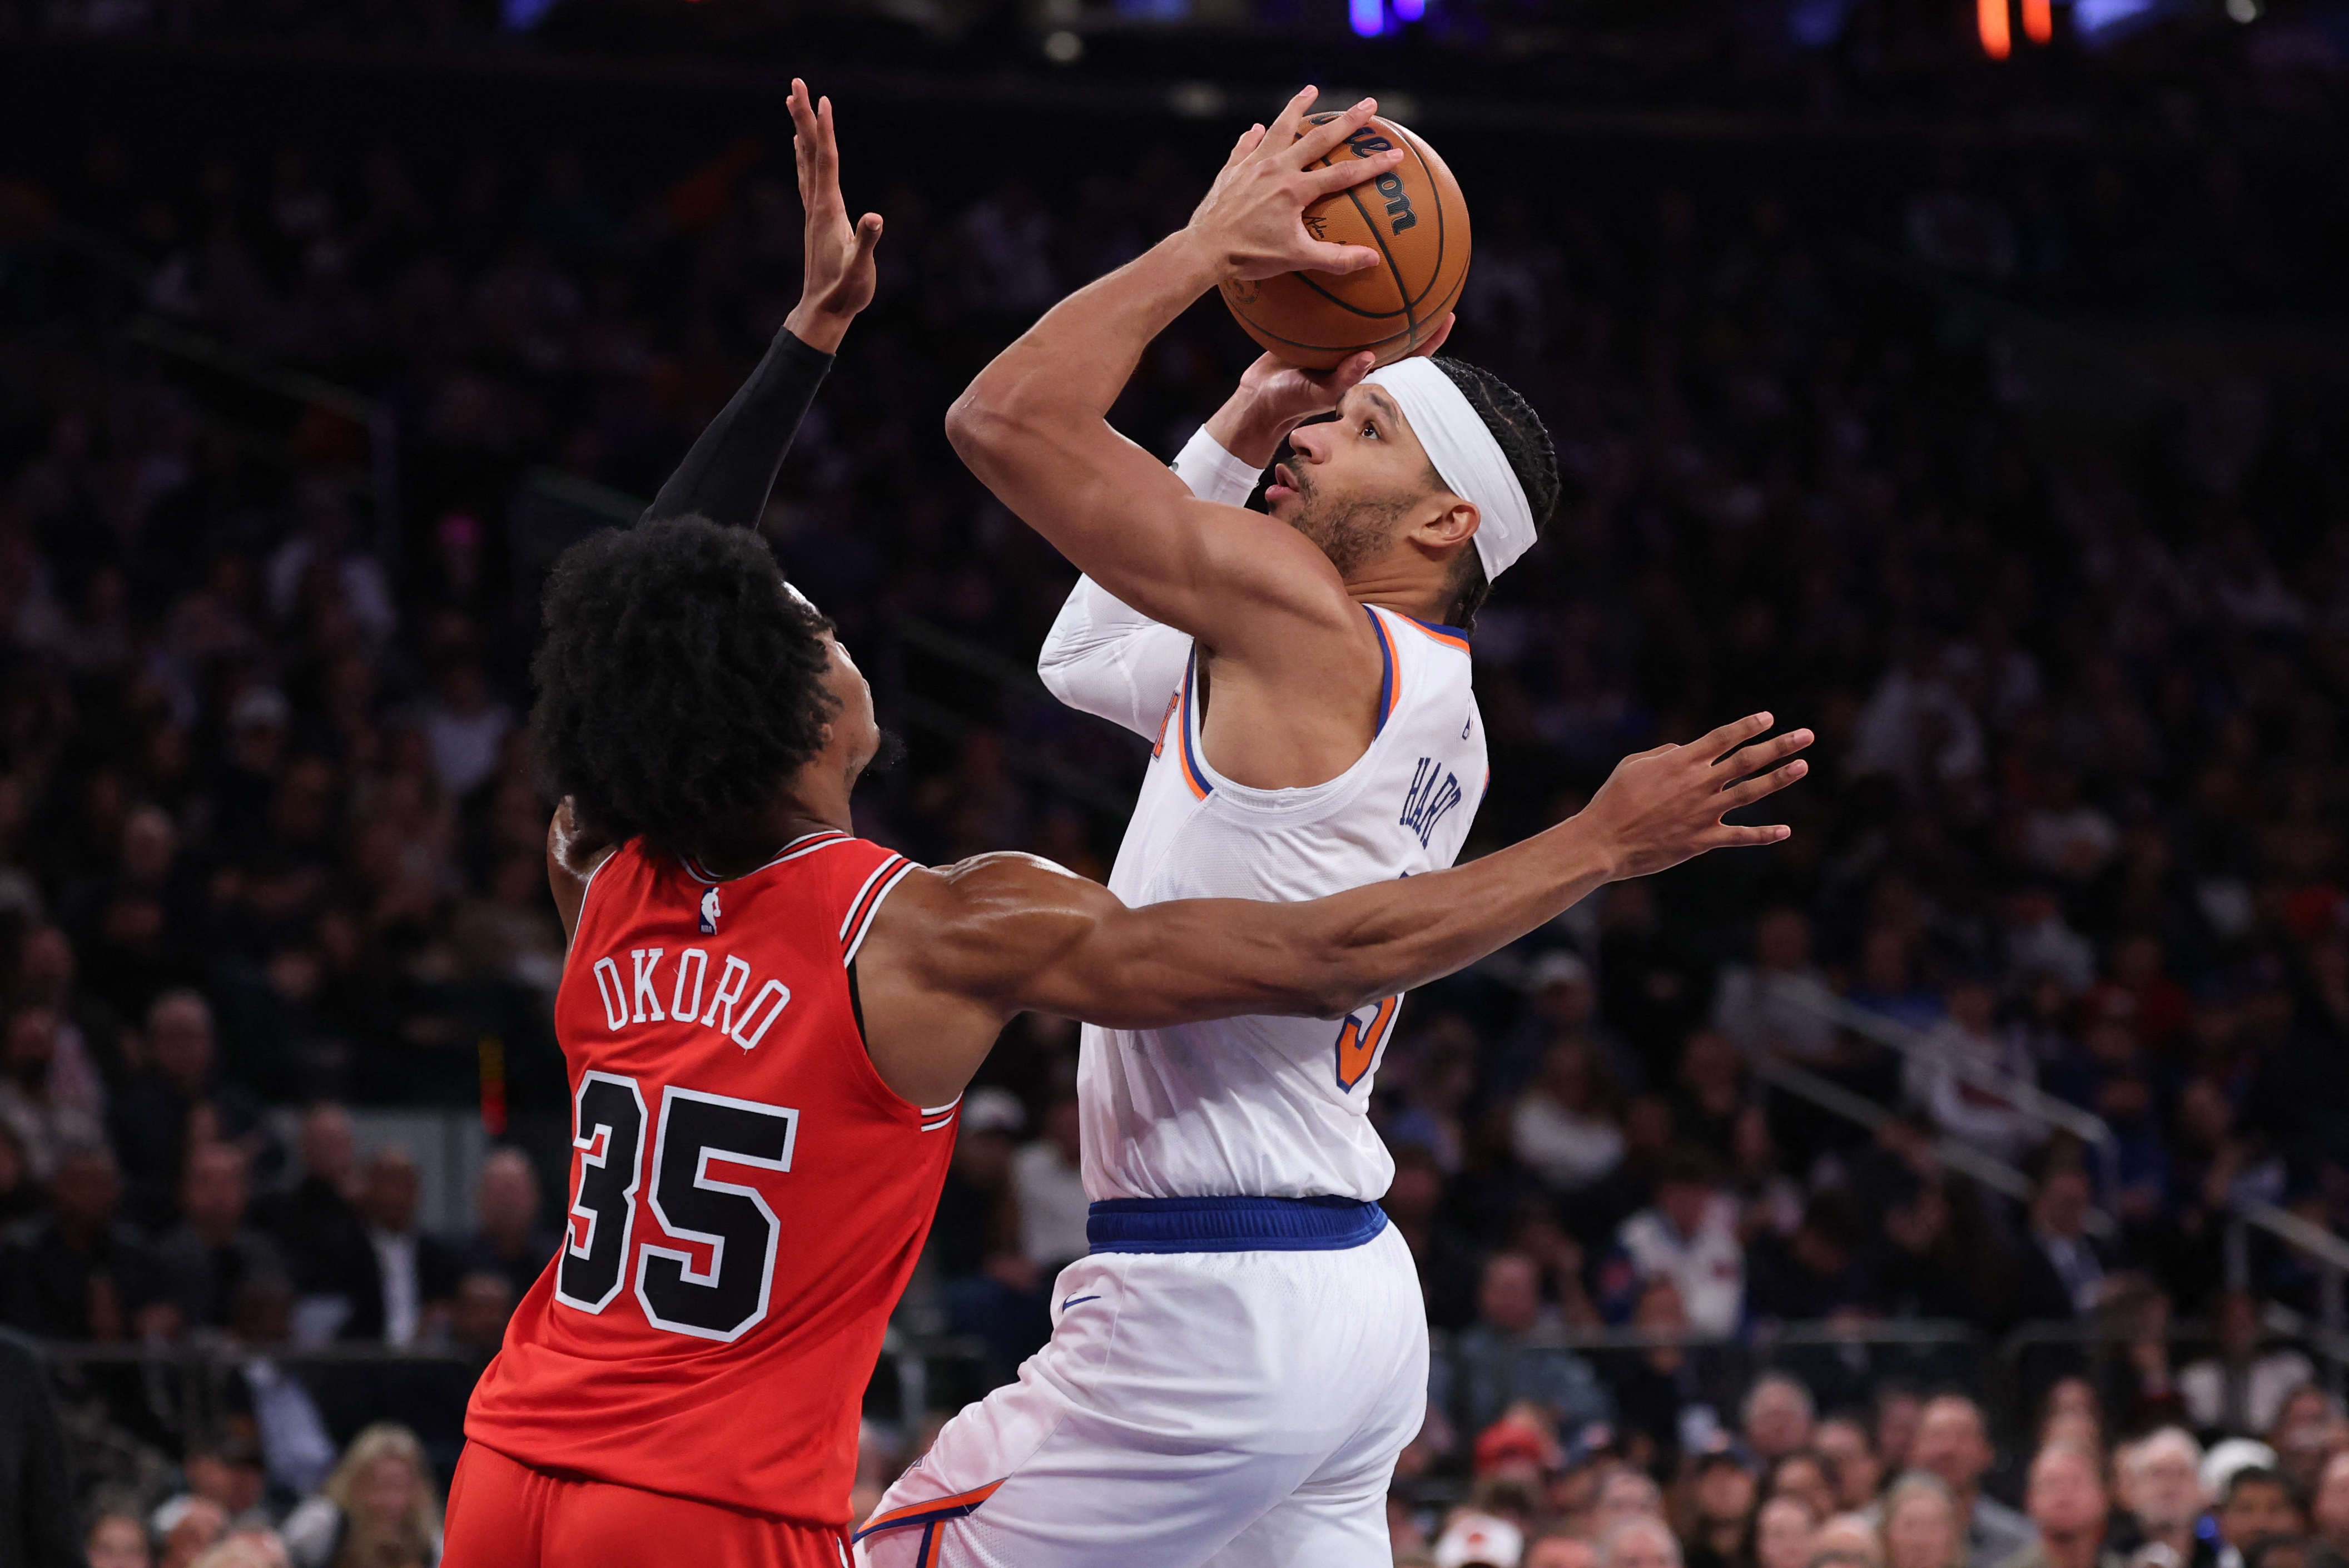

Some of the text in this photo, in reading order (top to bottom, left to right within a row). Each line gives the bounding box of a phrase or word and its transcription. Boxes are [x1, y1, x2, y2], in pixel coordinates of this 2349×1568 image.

[1399, 757, 1462, 850] HART
[701, 925, 712, 934] NBA
[593, 947, 791, 1050] OKORO
[554, 1070, 799, 1343] 35
